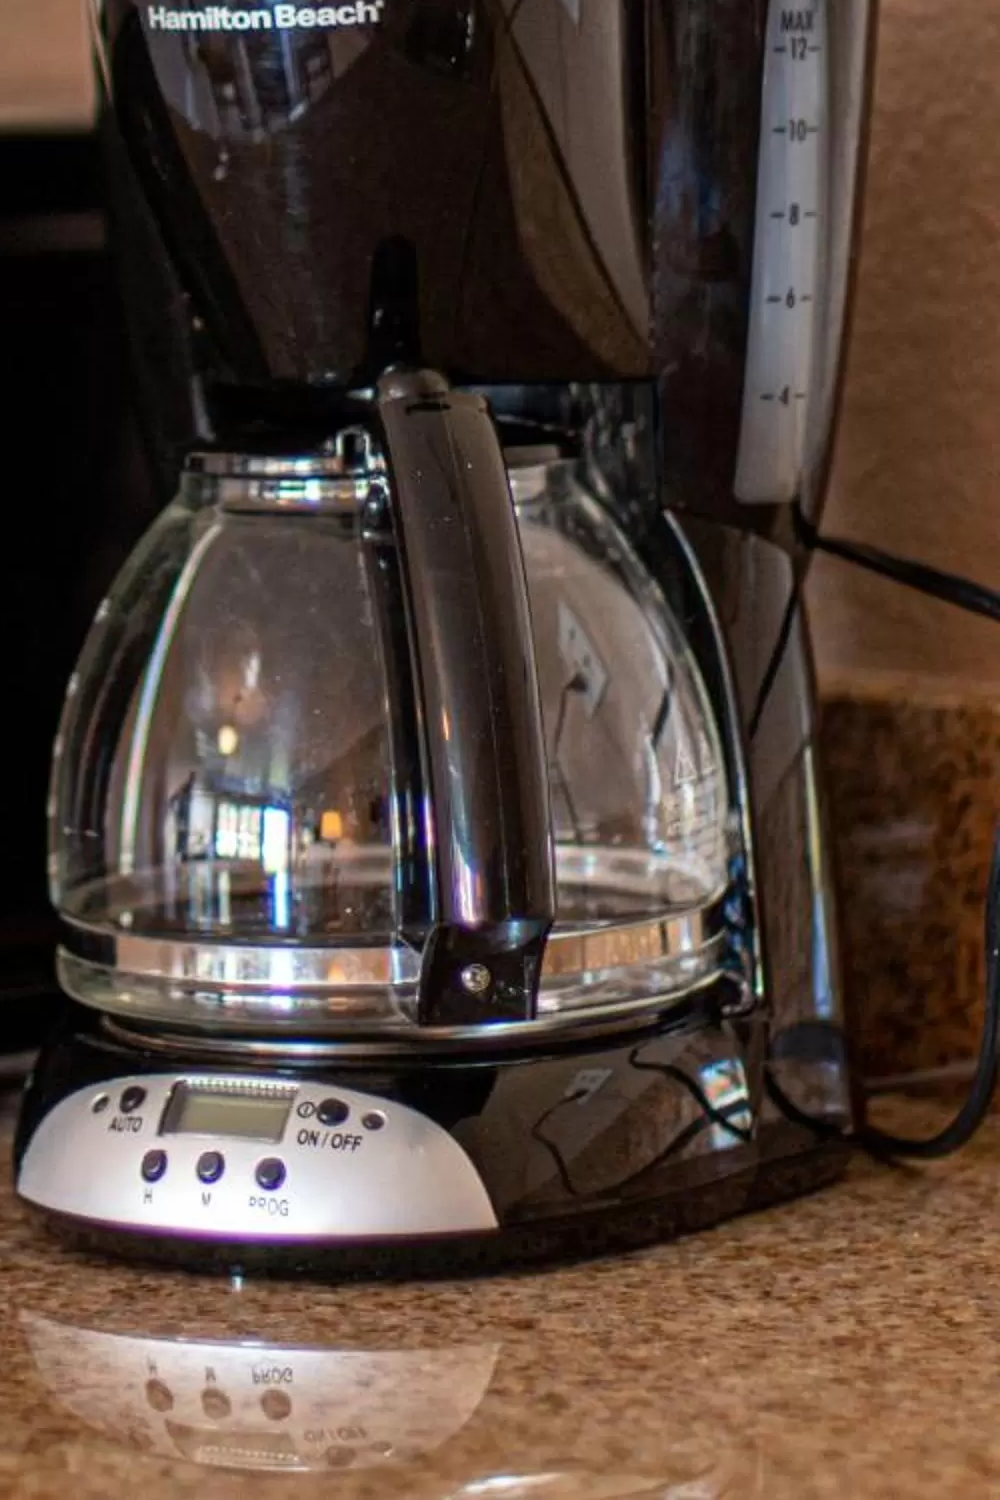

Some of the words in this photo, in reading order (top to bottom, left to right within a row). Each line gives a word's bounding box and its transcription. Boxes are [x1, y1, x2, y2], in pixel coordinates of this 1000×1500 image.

[147, 4, 272, 30] Hamilton
[780, 9, 813, 32] MAX
[791, 37, 808, 60] 12
[789, 118, 807, 141] 10
[788, 203, 799, 226] 8
[786, 286, 796, 309] 6
[778, 385, 790, 405] 4
[107, 1116, 143, 1133] AUTO
